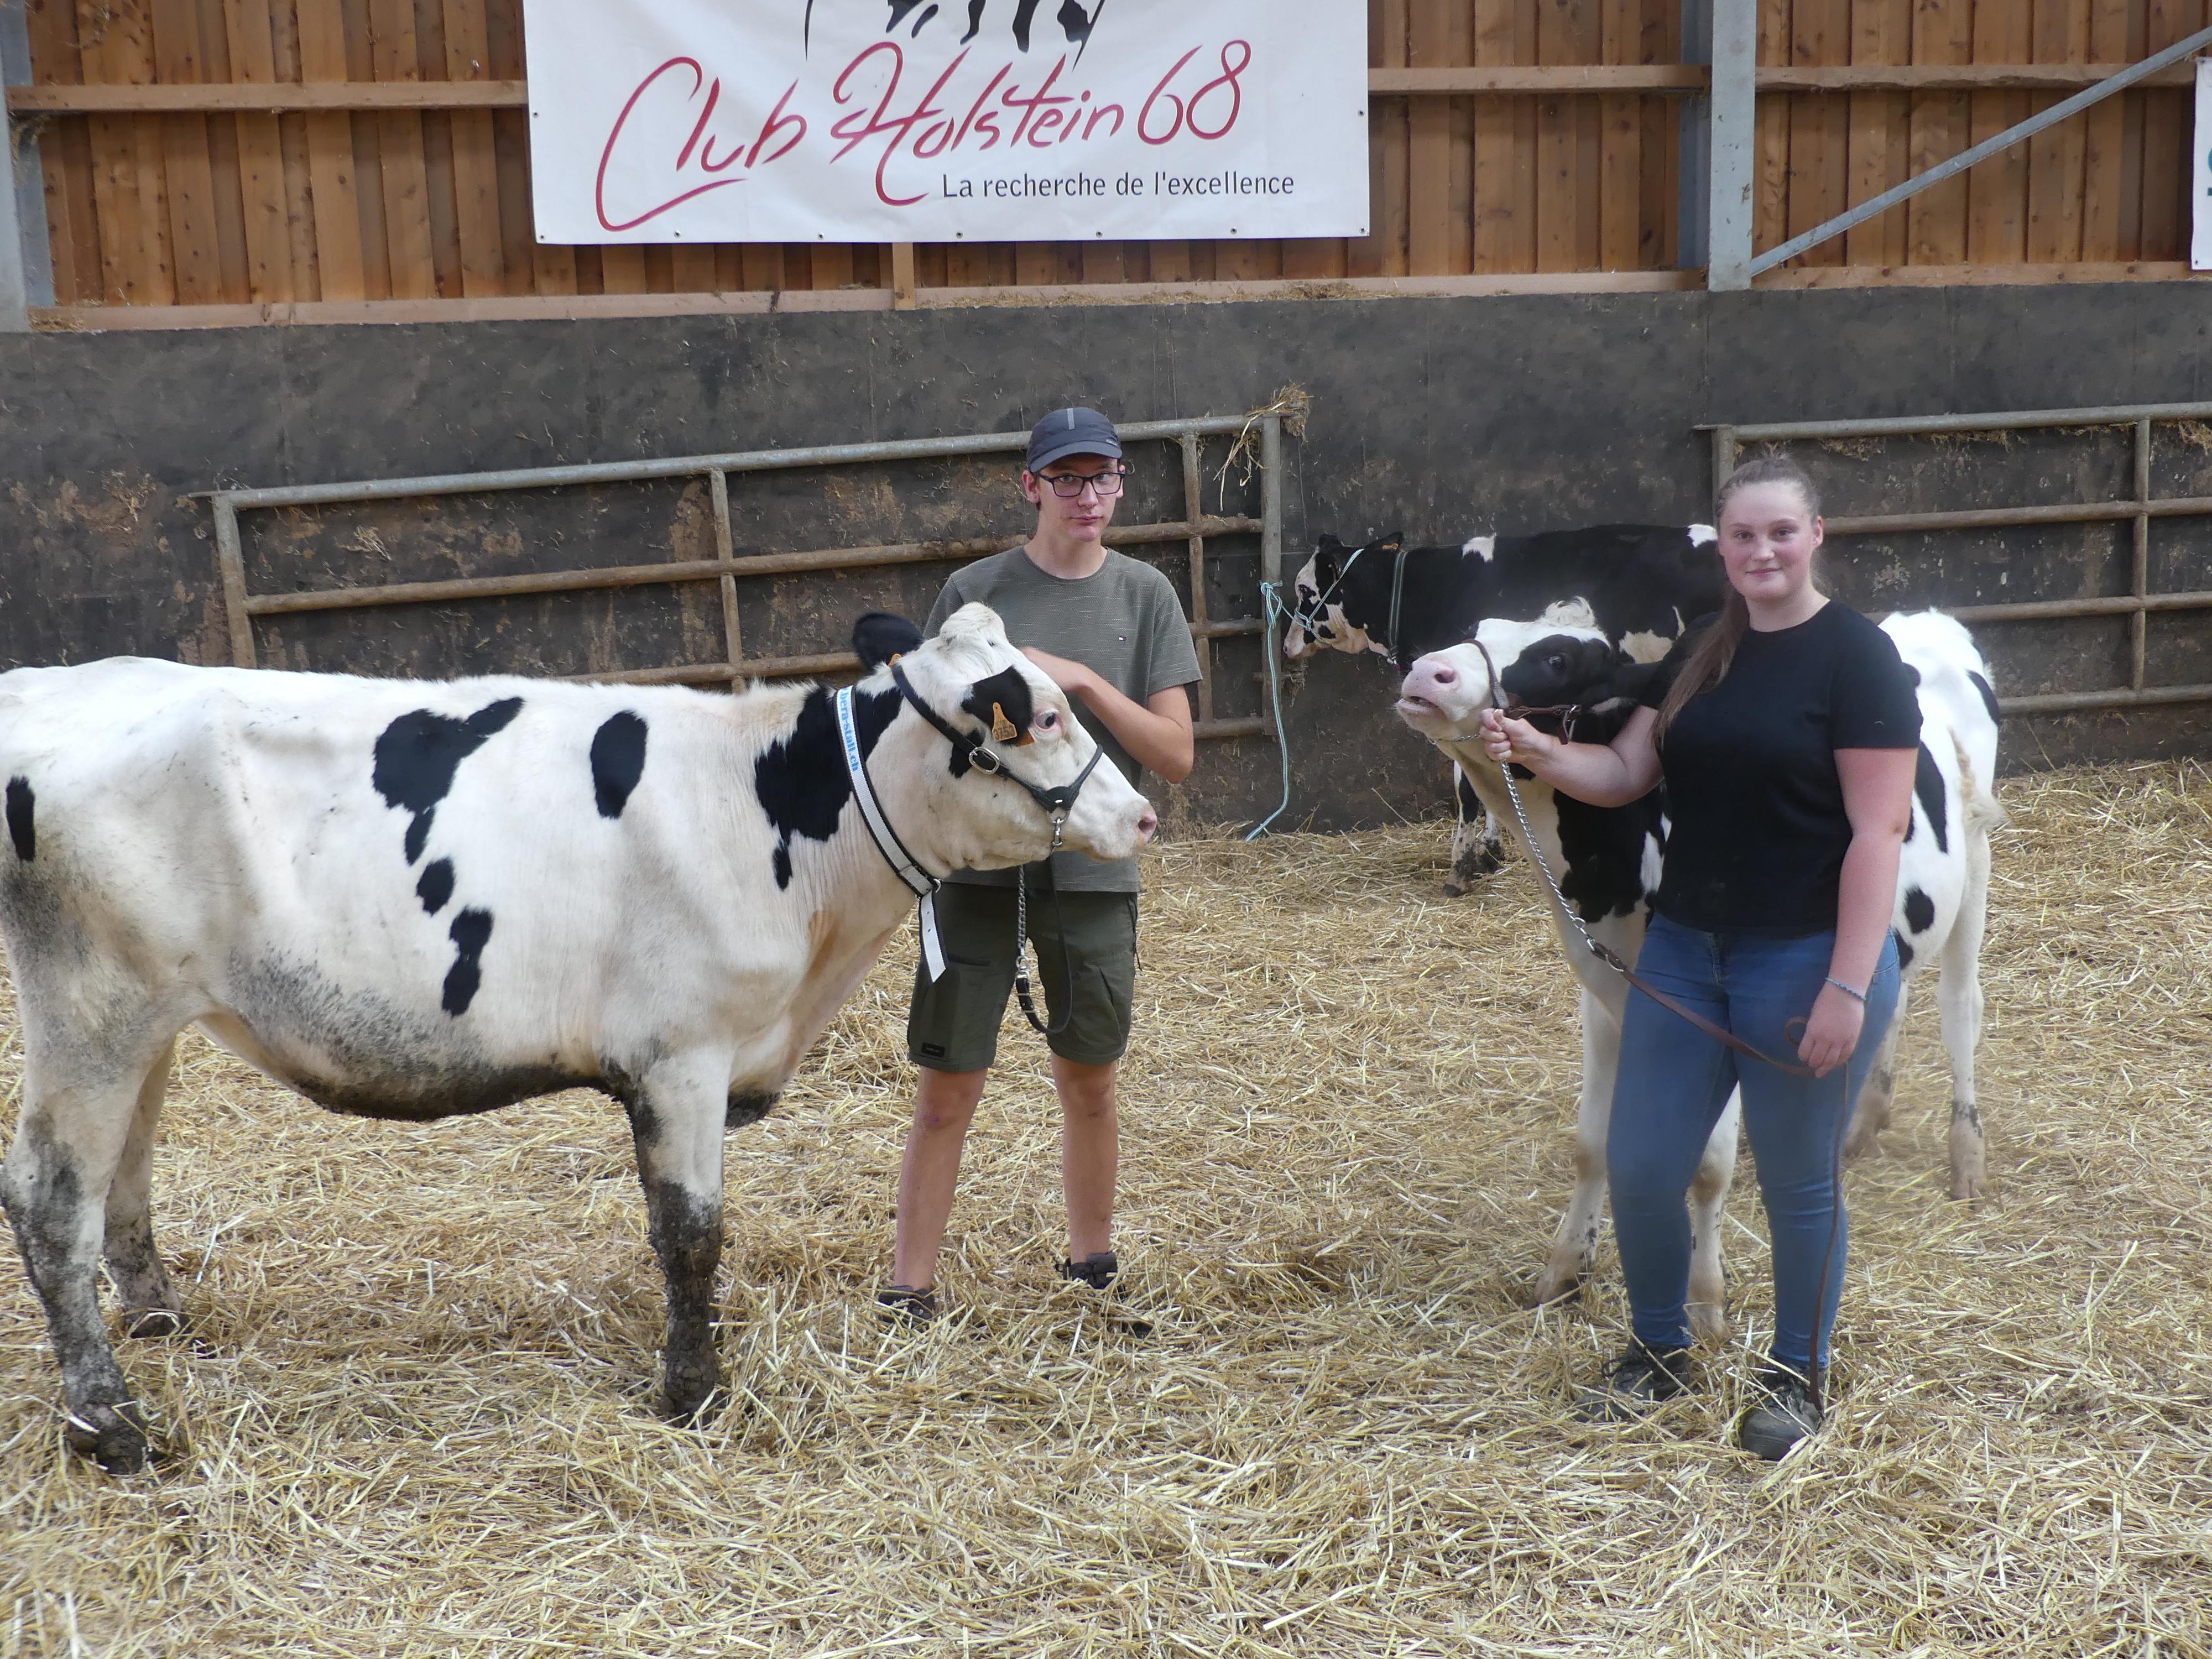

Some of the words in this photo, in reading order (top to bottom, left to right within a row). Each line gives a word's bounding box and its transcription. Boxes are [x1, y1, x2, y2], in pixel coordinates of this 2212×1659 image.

[596, 56, 807, 231] Club
[830, 41, 1125, 206] Holstein
[1137, 39, 1252, 145] 68
[942, 173, 973, 198] La
[983, 173, 1106, 197] recherche
[1115, 171, 1144, 196] de
[1155, 170, 1295, 196] l'excellence
